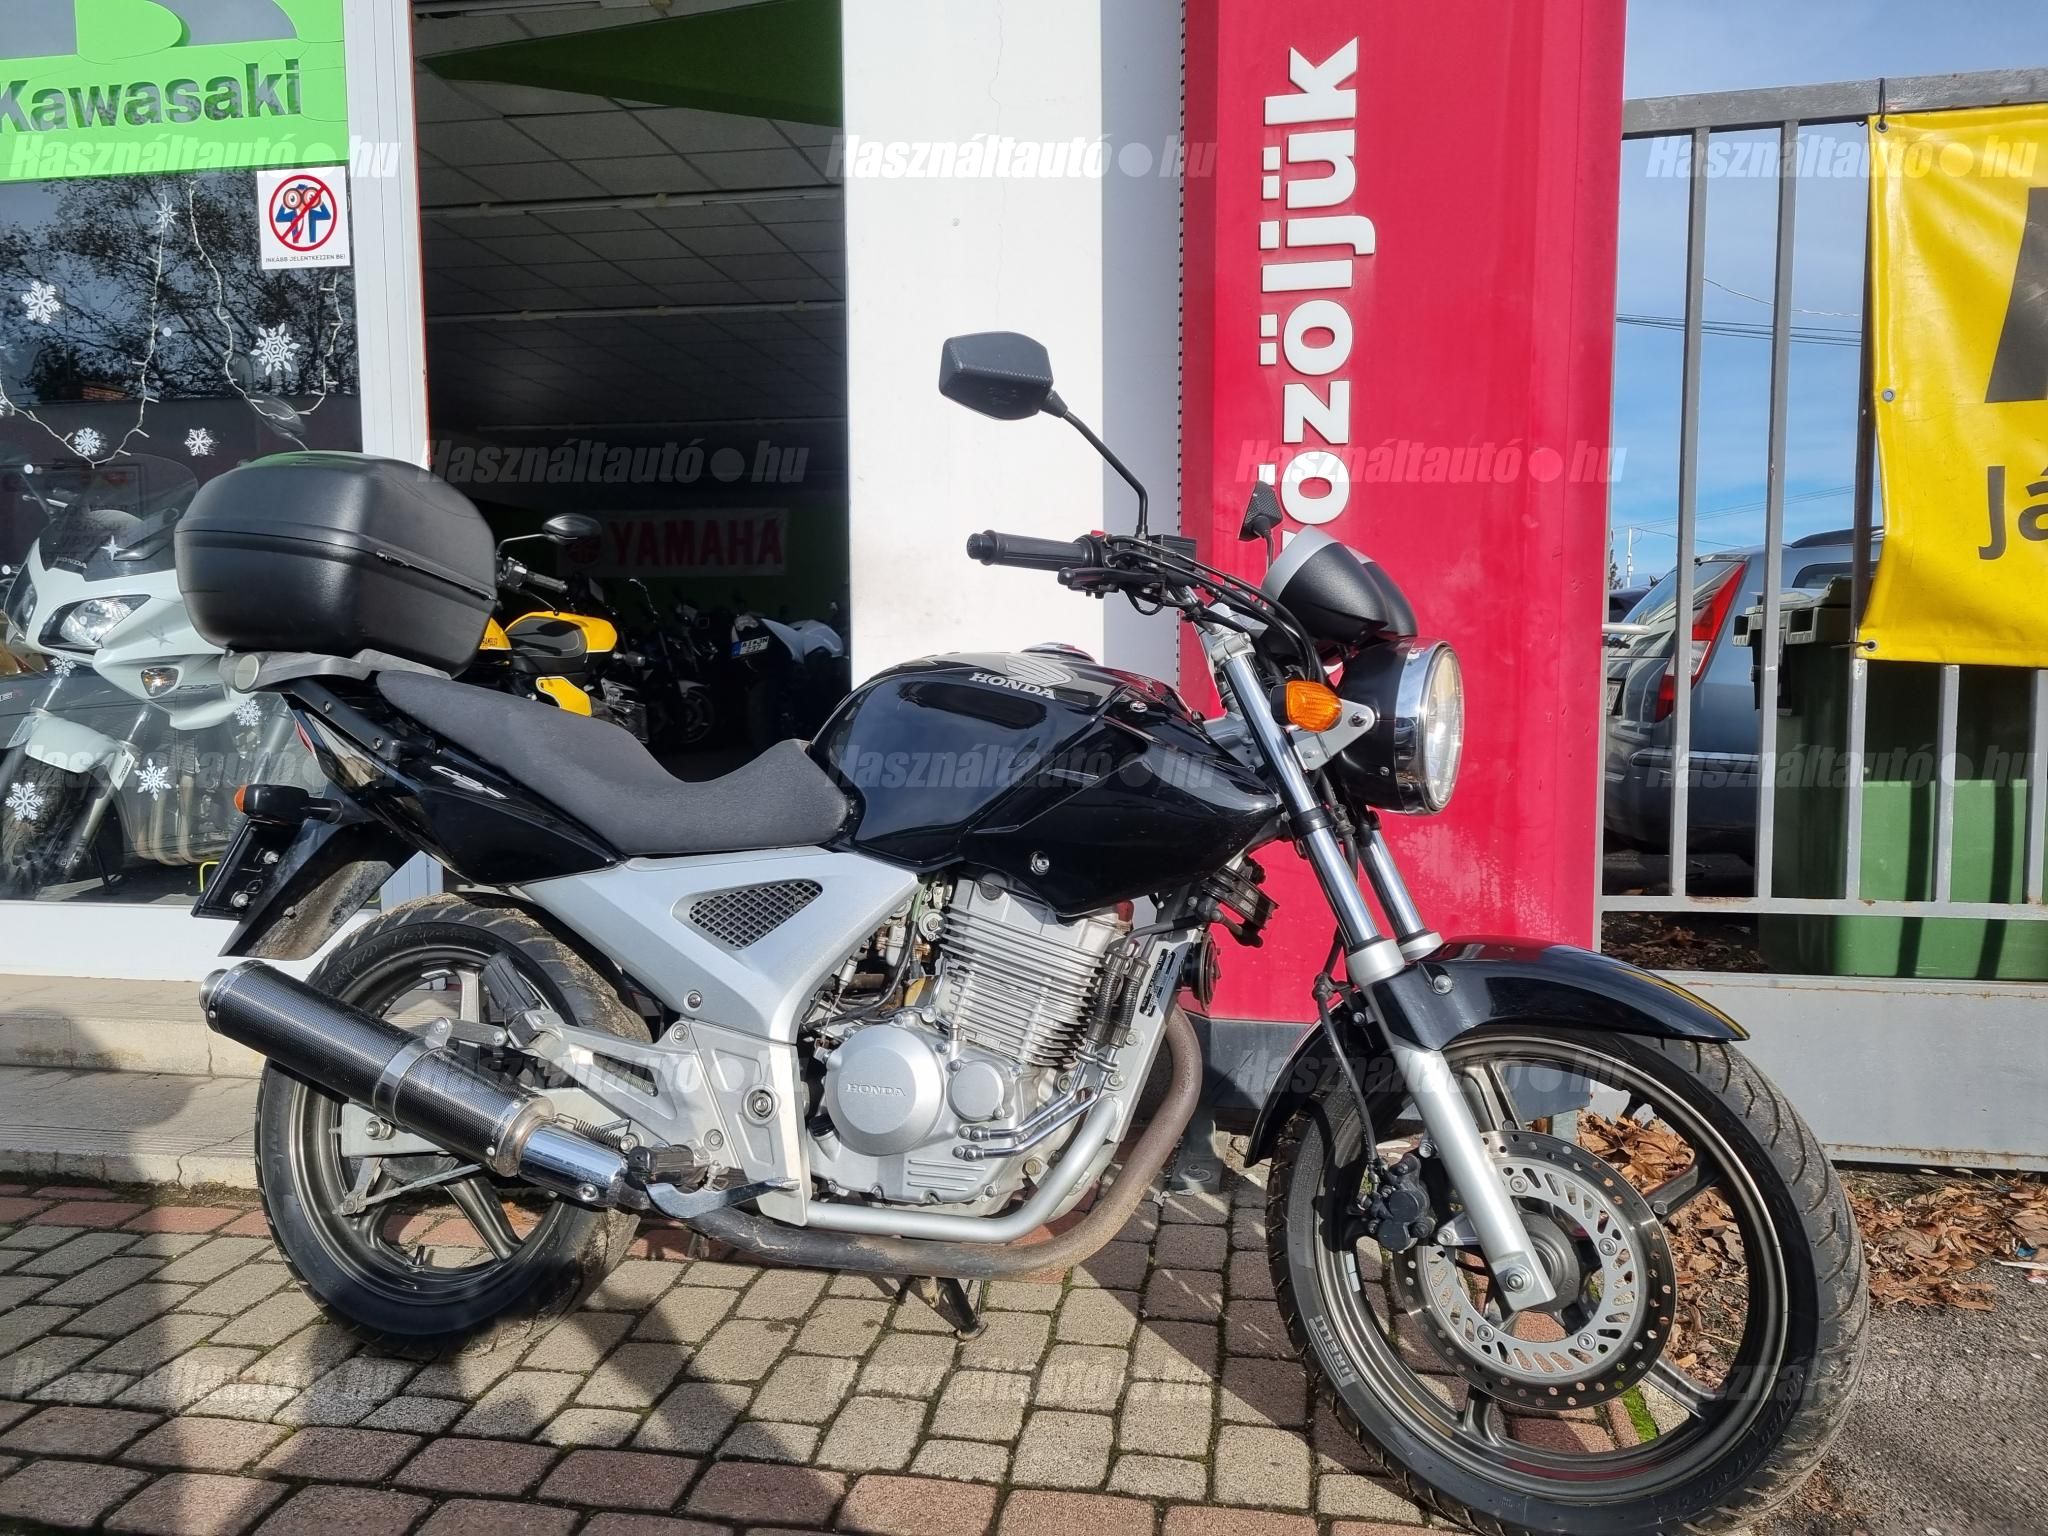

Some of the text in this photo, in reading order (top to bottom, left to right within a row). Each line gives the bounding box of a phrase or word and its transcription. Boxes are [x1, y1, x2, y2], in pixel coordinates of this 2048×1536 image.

[0, 58, 302, 133] Kawasaki
[1258, 36, 1376, 553] özöljük
[607, 517, 784, 568] YAMAHA
[969, 671, 1056, 700] HONDA
[846, 1082, 907, 1097] HONDA
